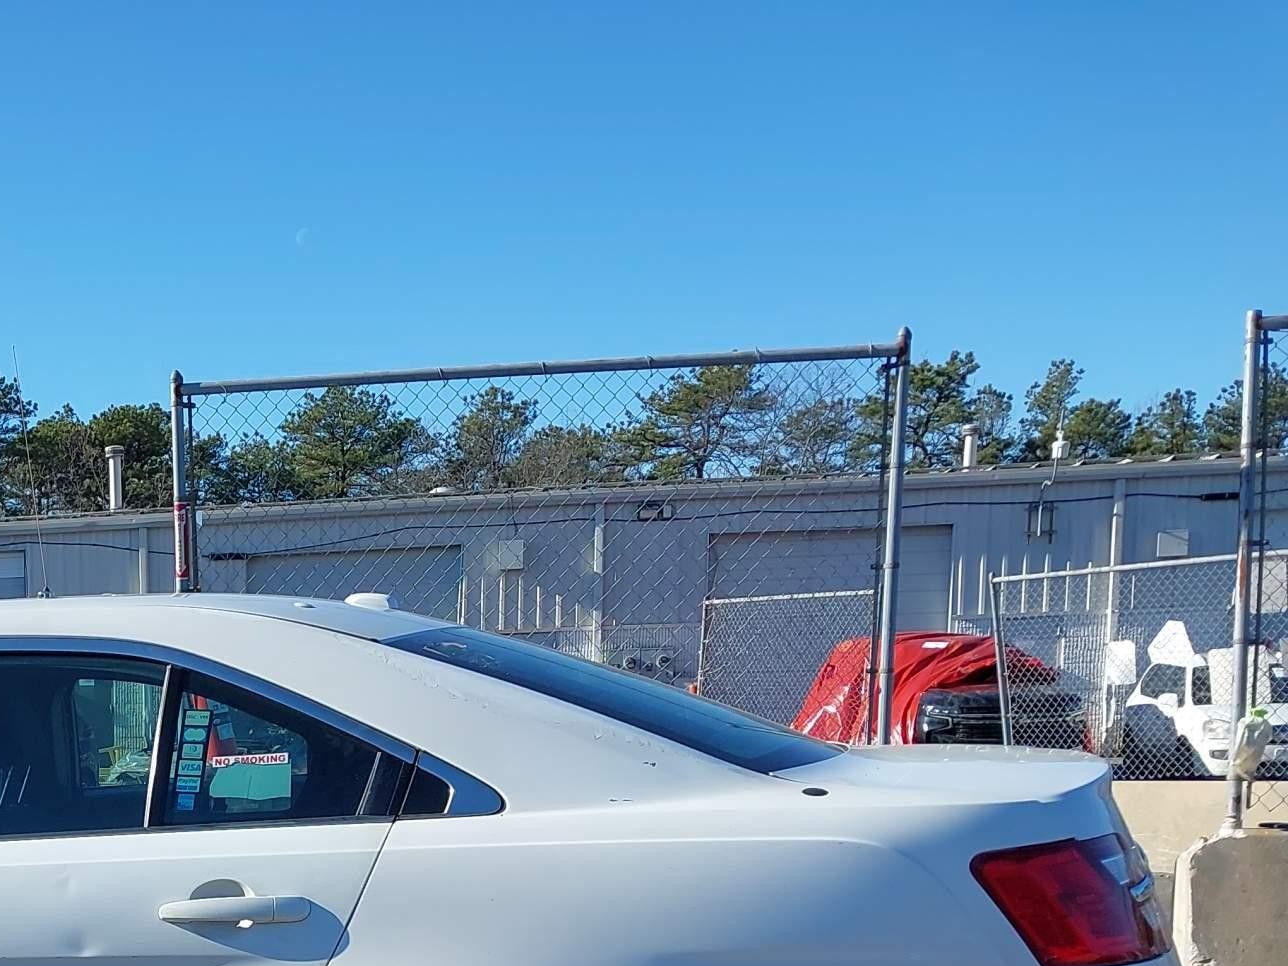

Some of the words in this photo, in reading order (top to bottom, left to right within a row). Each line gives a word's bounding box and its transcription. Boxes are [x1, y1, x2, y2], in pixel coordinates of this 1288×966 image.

[215, 758, 230, 766] NO
[234, 754, 286, 765] SMOKING
[181, 763, 201, 771] VISA
